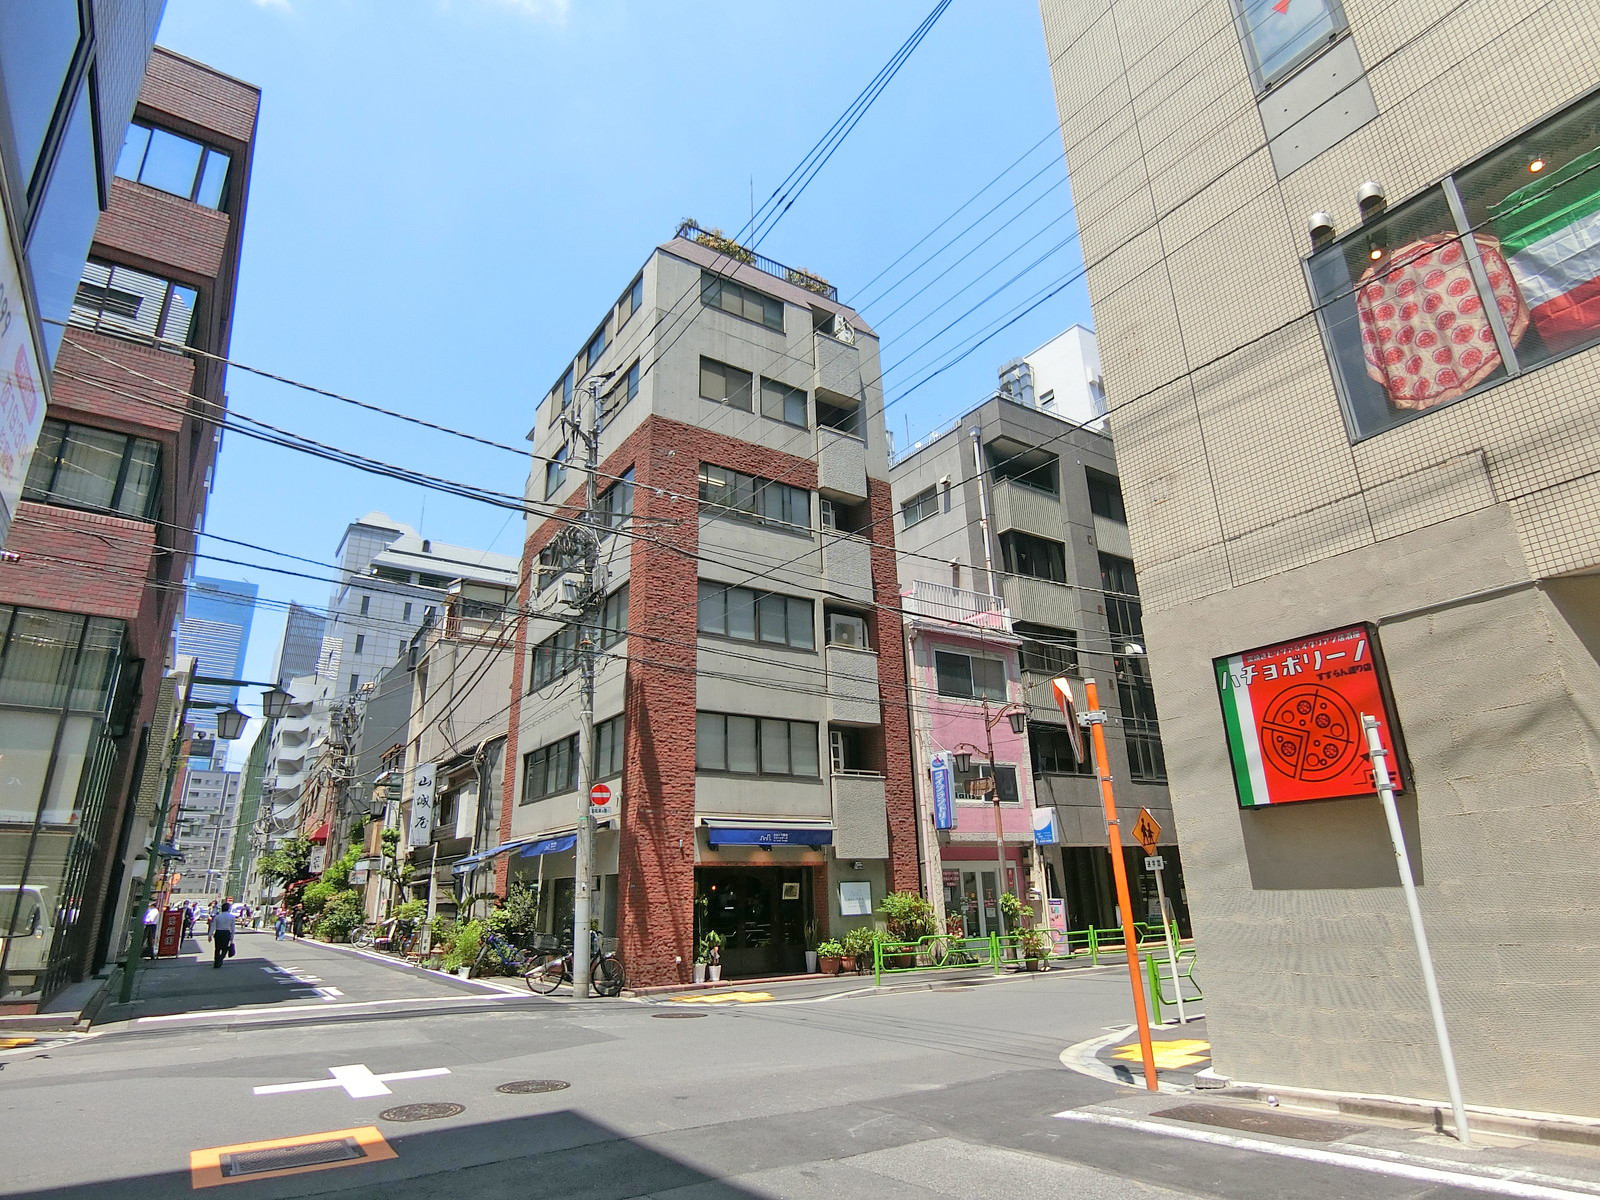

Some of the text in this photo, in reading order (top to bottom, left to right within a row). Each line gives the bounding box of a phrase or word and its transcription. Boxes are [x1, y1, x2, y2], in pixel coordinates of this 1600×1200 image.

[1220, 640, 1366, 691] ハチョボリーノ
[414, 776, 432, 829] 山城屋
